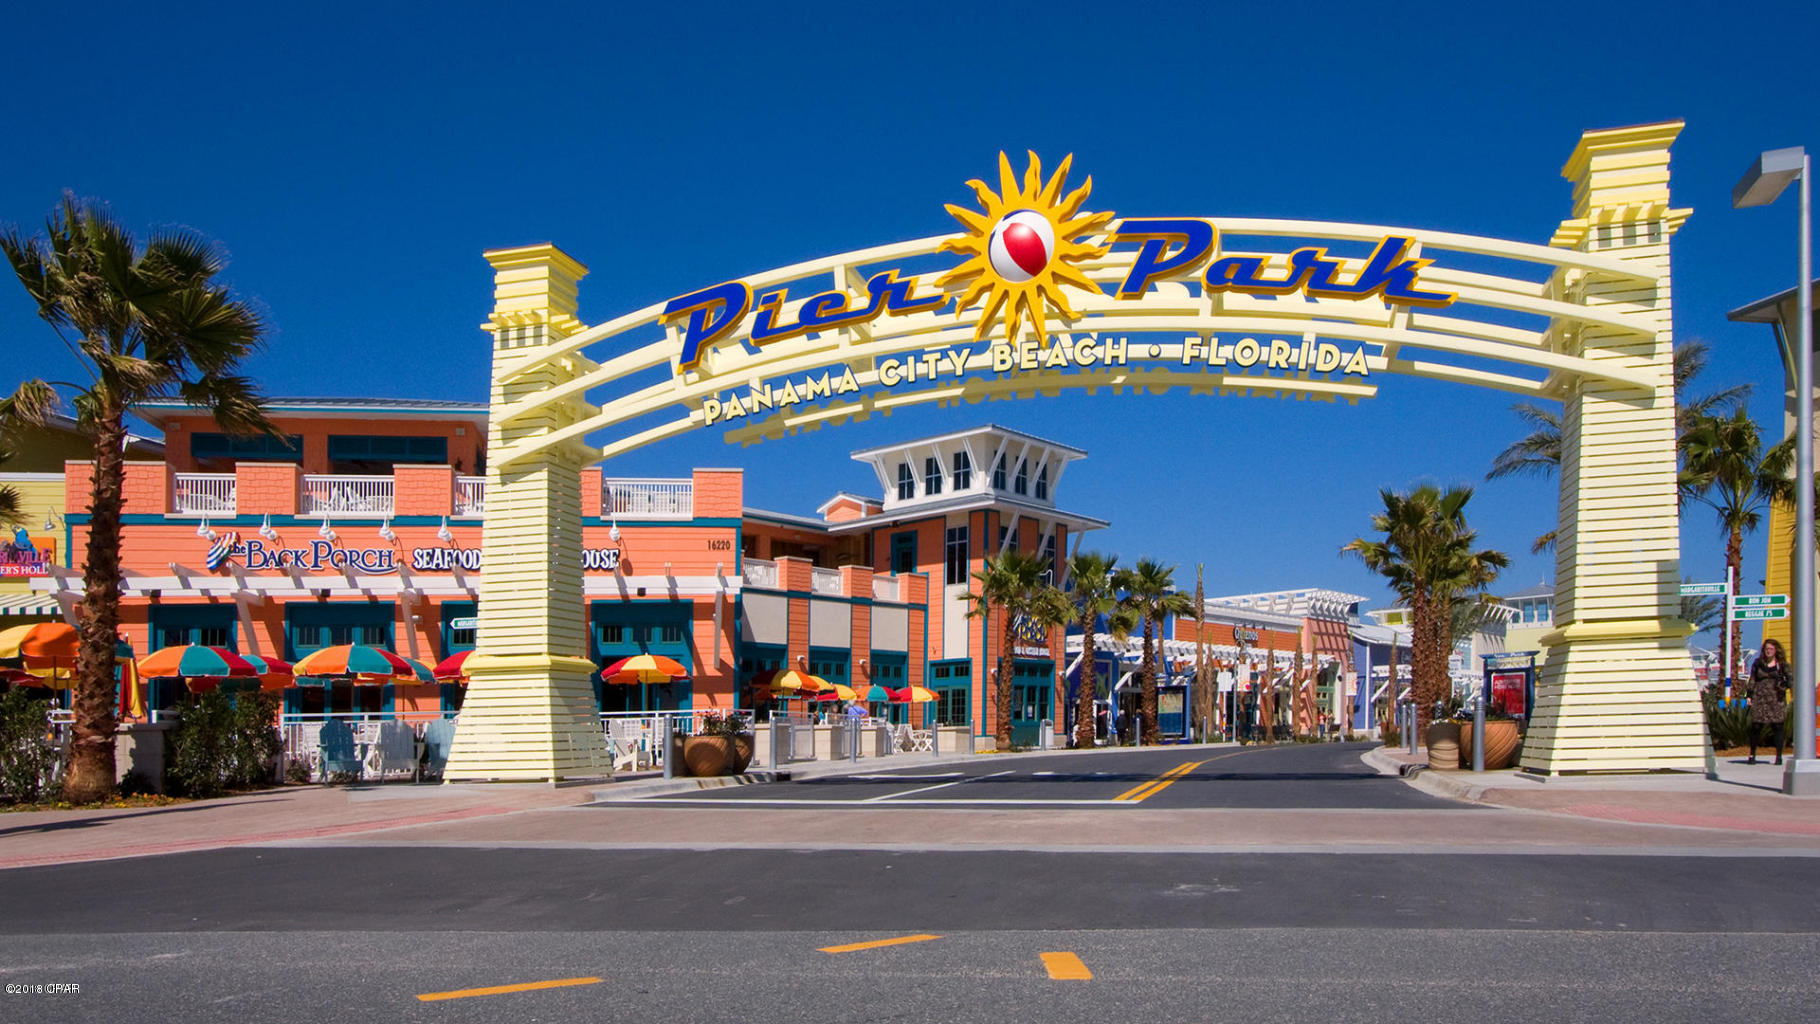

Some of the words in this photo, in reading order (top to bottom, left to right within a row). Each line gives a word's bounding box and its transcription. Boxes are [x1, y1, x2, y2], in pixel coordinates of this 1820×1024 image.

[658, 268, 950, 374] Pier
[1105, 217, 1459, 308] Park
[703, 366, 860, 426] PANAMA
[878, 347, 971, 387] CITY
[992, 337, 1129, 372] BEACH
[1182, 337, 1370, 376] FLORIDA
[412, 547, 481, 570] SEAFOOD
[581, 548, 620, 570] OUSE
[707, 540, 731, 551] 16220
